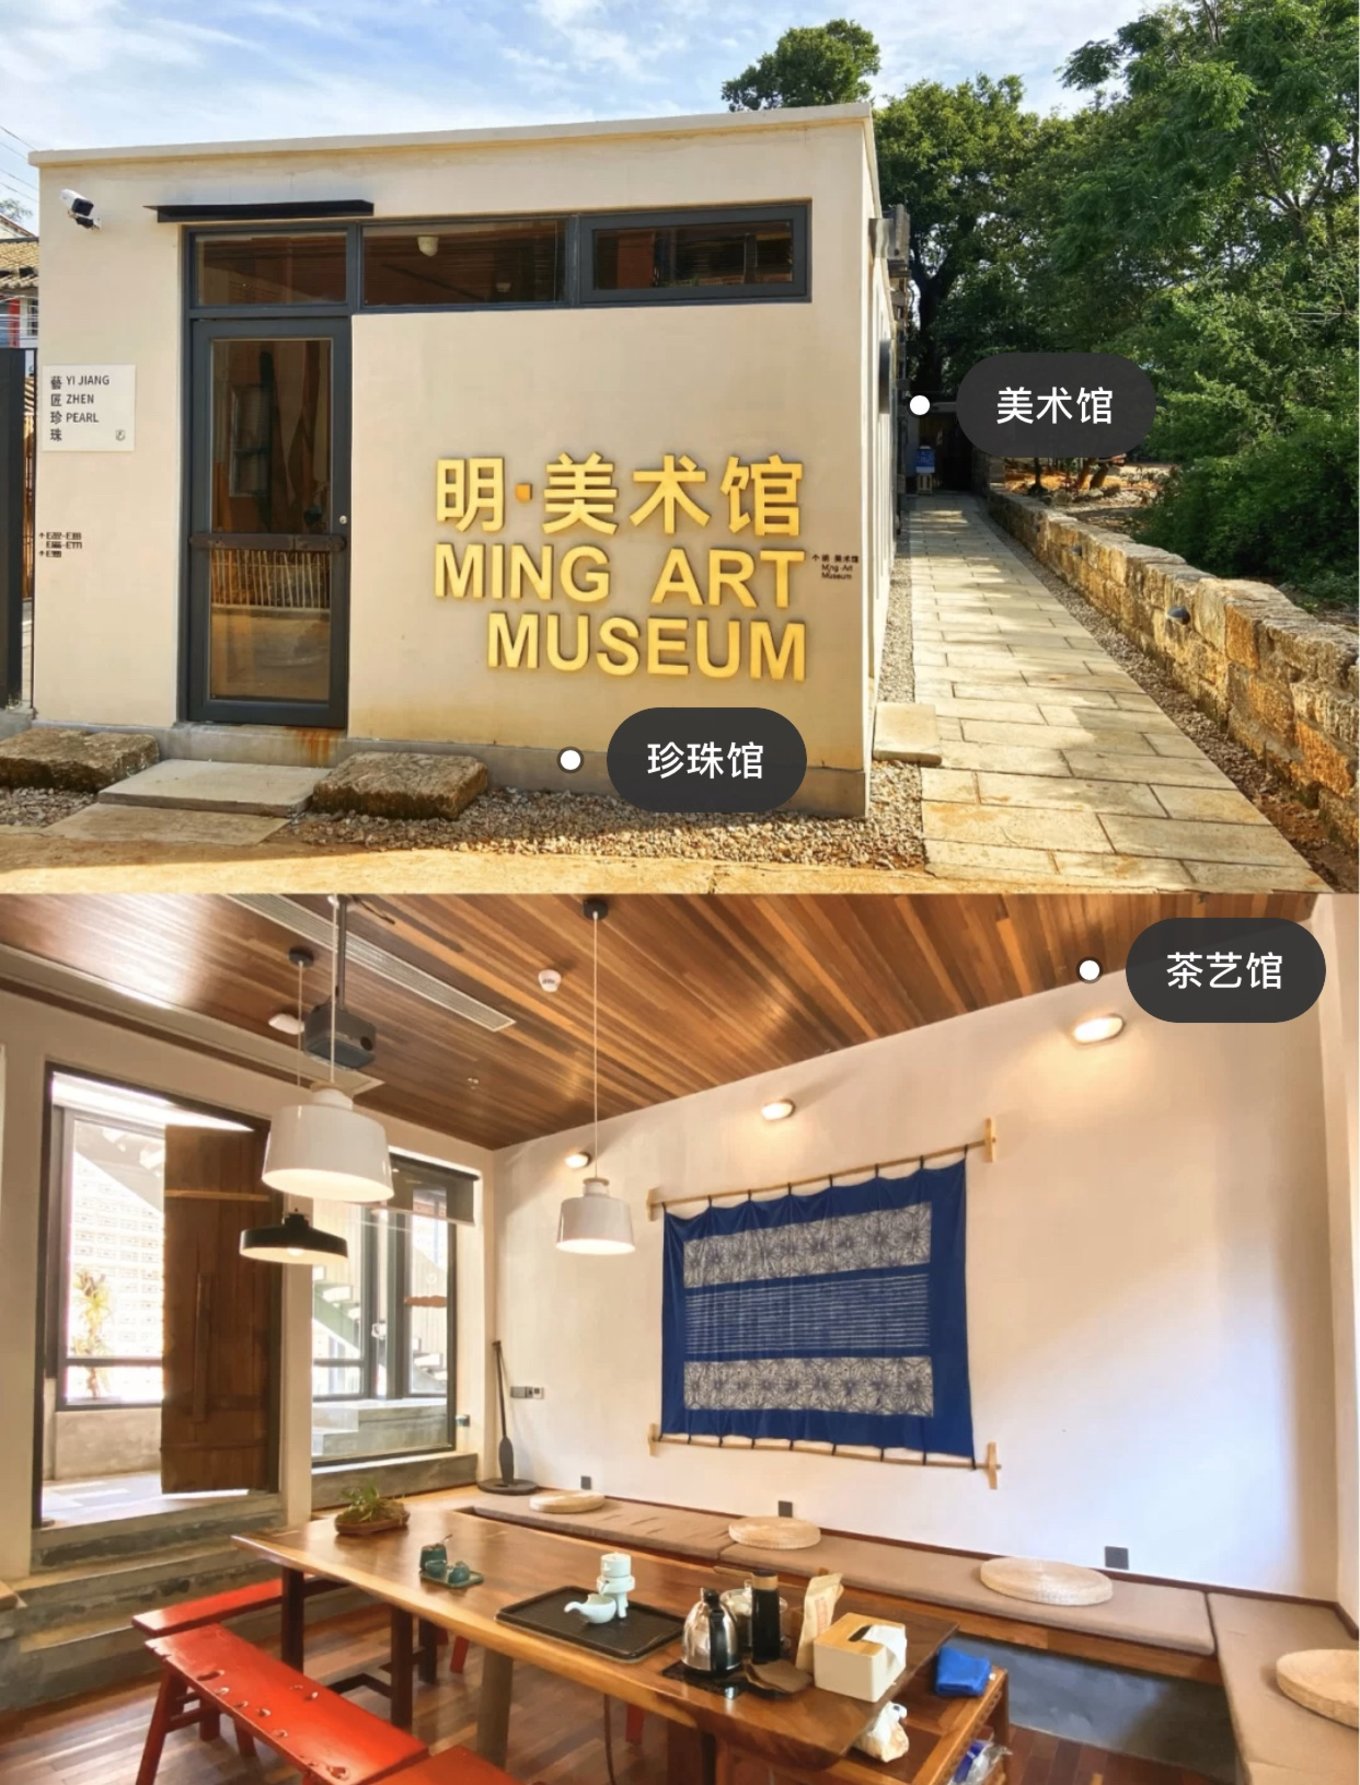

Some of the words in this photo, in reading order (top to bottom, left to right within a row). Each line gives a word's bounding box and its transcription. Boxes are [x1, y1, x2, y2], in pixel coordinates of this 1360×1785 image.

[66, 375, 76, 385] YI
[78, 375, 110, 385] JIANG
[66, 394, 95, 404] ZHEN
[66, 412, 99, 423] PEARL
[434, 543, 610, 602] MING
[650, 548, 805, 608] ART
[487, 612, 806, 682] MUSEUM
